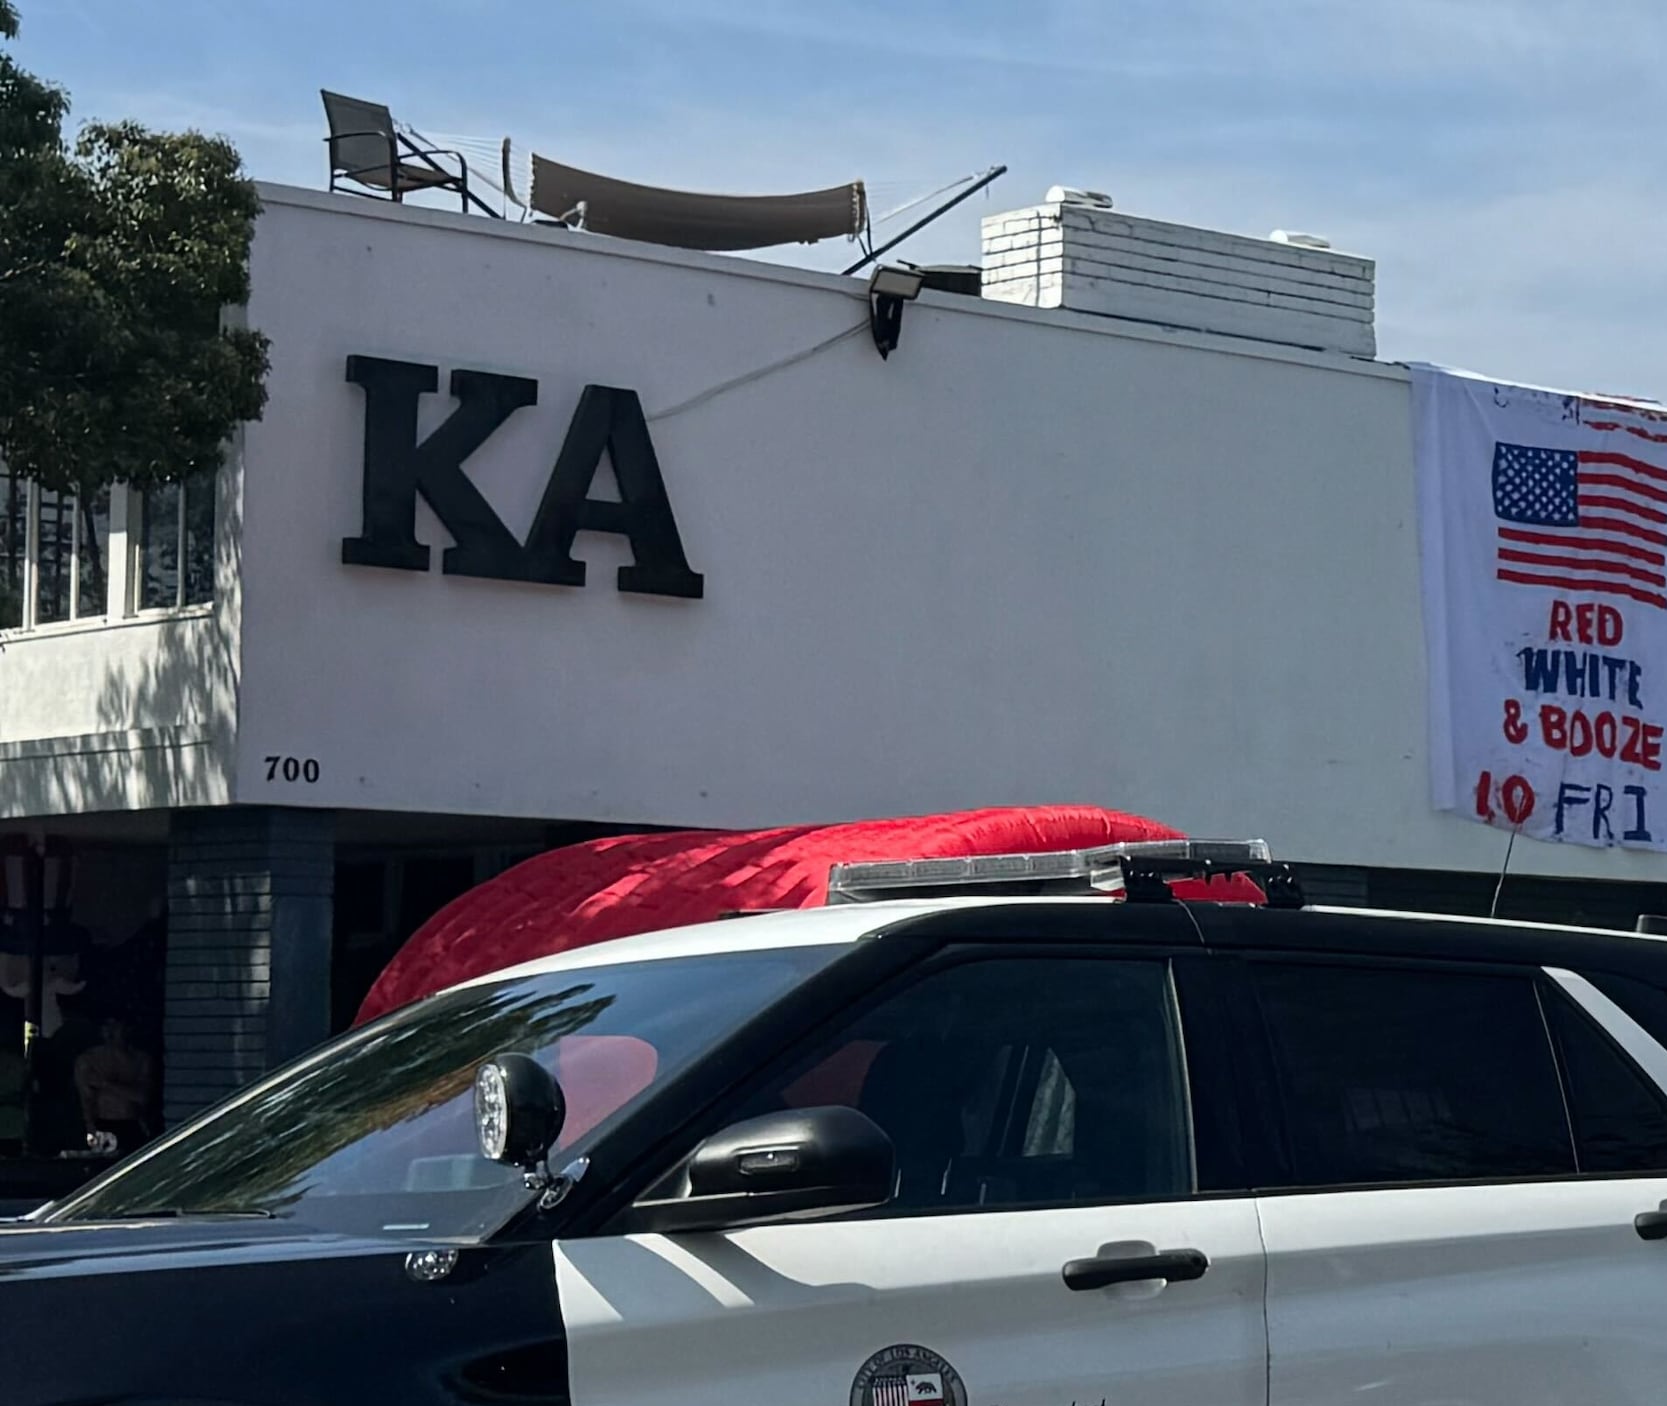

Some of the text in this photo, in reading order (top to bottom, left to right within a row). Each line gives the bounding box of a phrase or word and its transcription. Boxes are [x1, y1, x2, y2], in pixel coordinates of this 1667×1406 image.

[341, 354, 704, 599] KA
[1548, 600, 1624, 646] RED
[1516, 646, 1643, 710] WHITE
[1502, 699, 1664, 771] & BOOZE
[263, 757, 321, 783] 700
[1554, 781, 1653, 843] FRI
